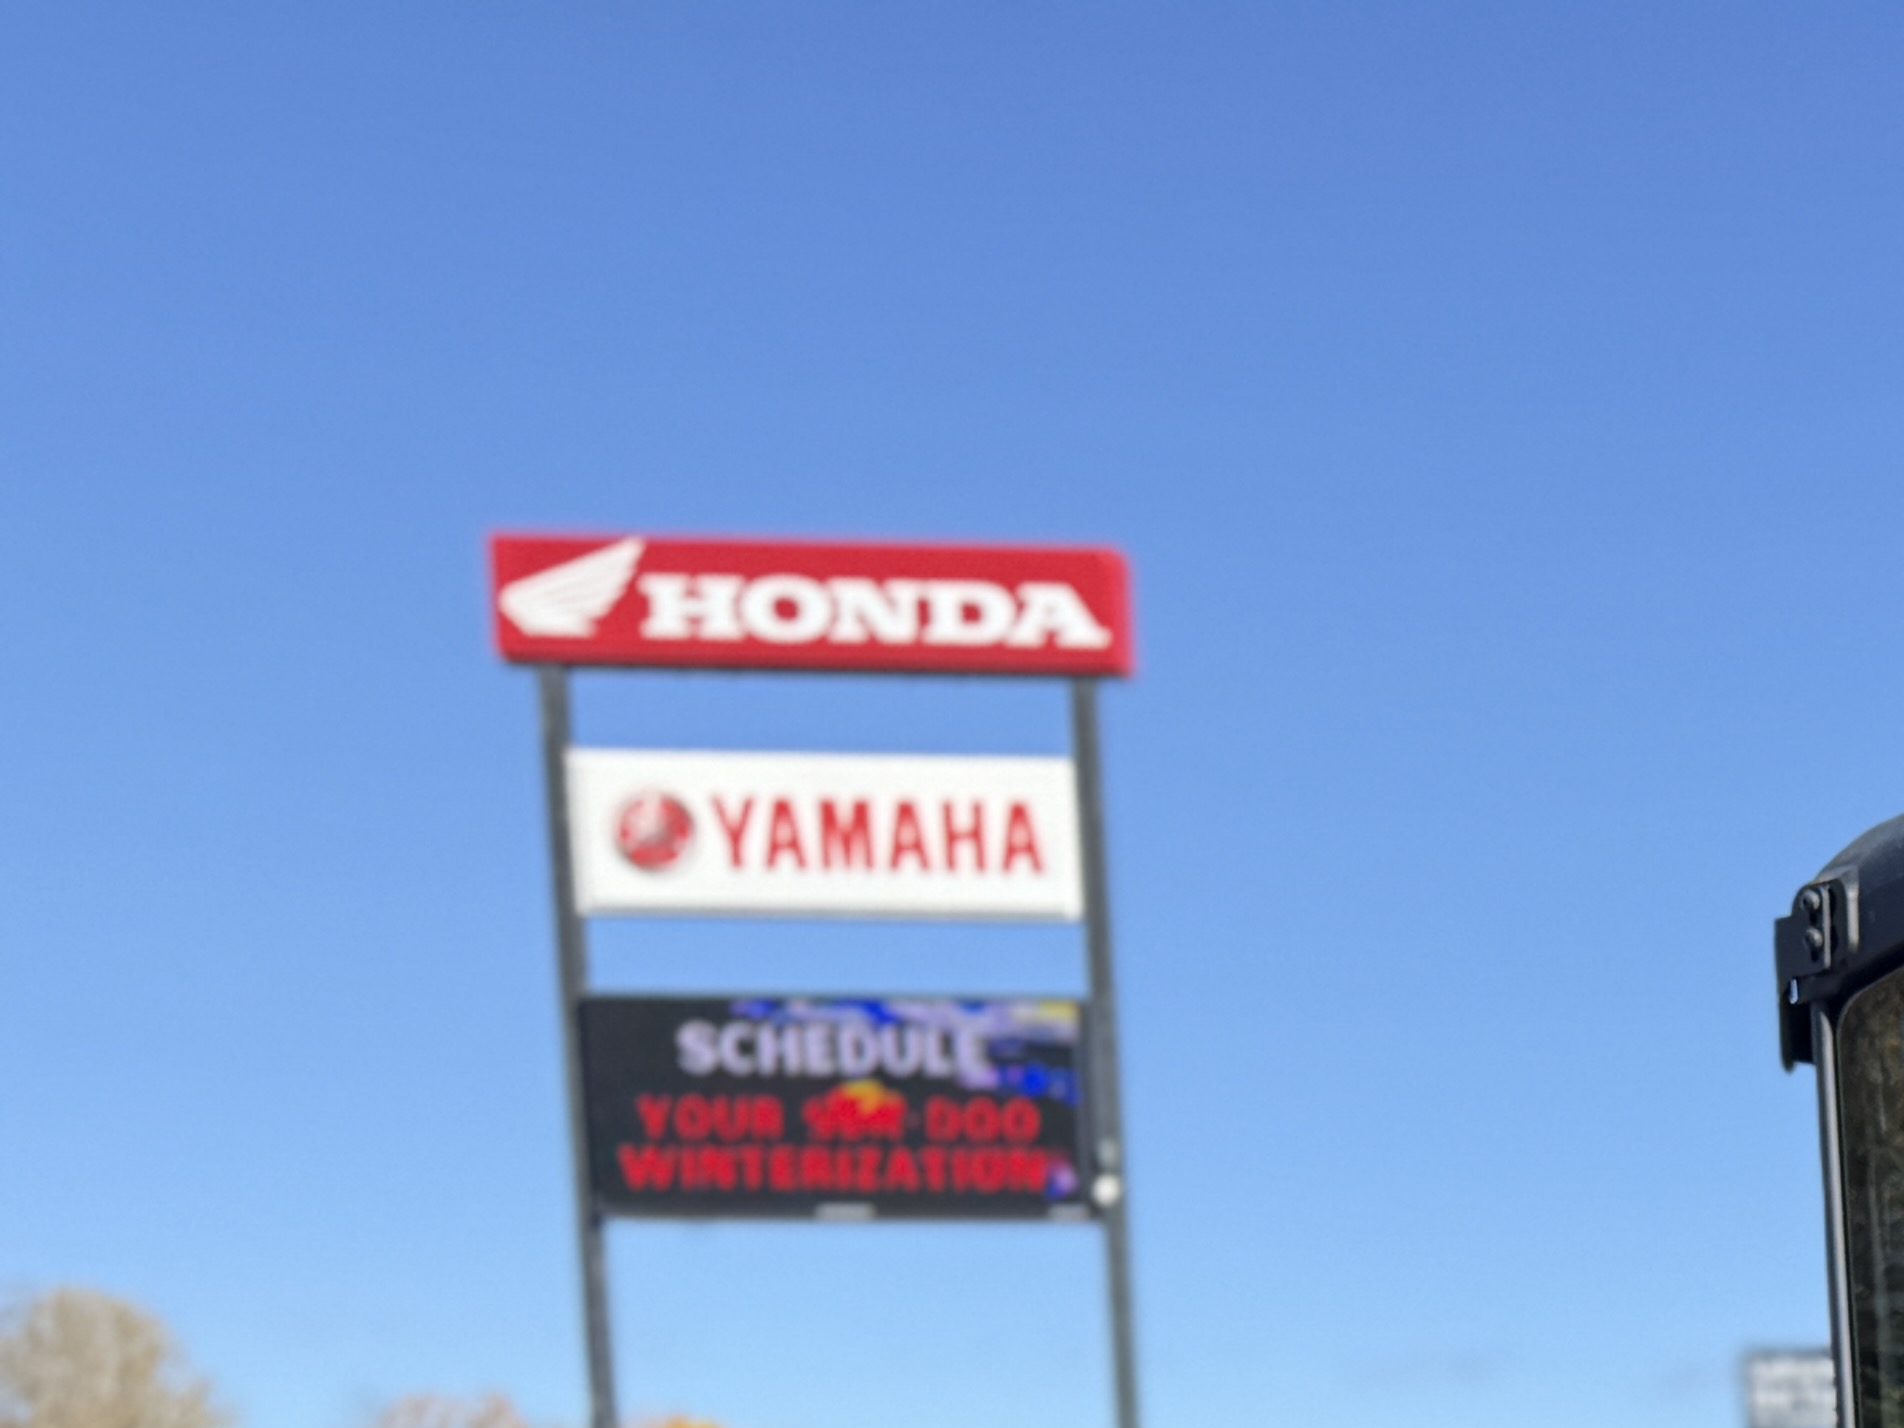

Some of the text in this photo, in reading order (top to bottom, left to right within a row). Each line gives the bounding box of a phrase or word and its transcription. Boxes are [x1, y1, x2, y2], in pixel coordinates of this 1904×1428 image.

[639, 573, 1113, 650] HONDA
[709, 793, 1045, 874] YAMAHA
[637, 1094, 1041, 1143] YOUR S-DOO
[618, 1145, 1052, 1191] WINTERIZATION
